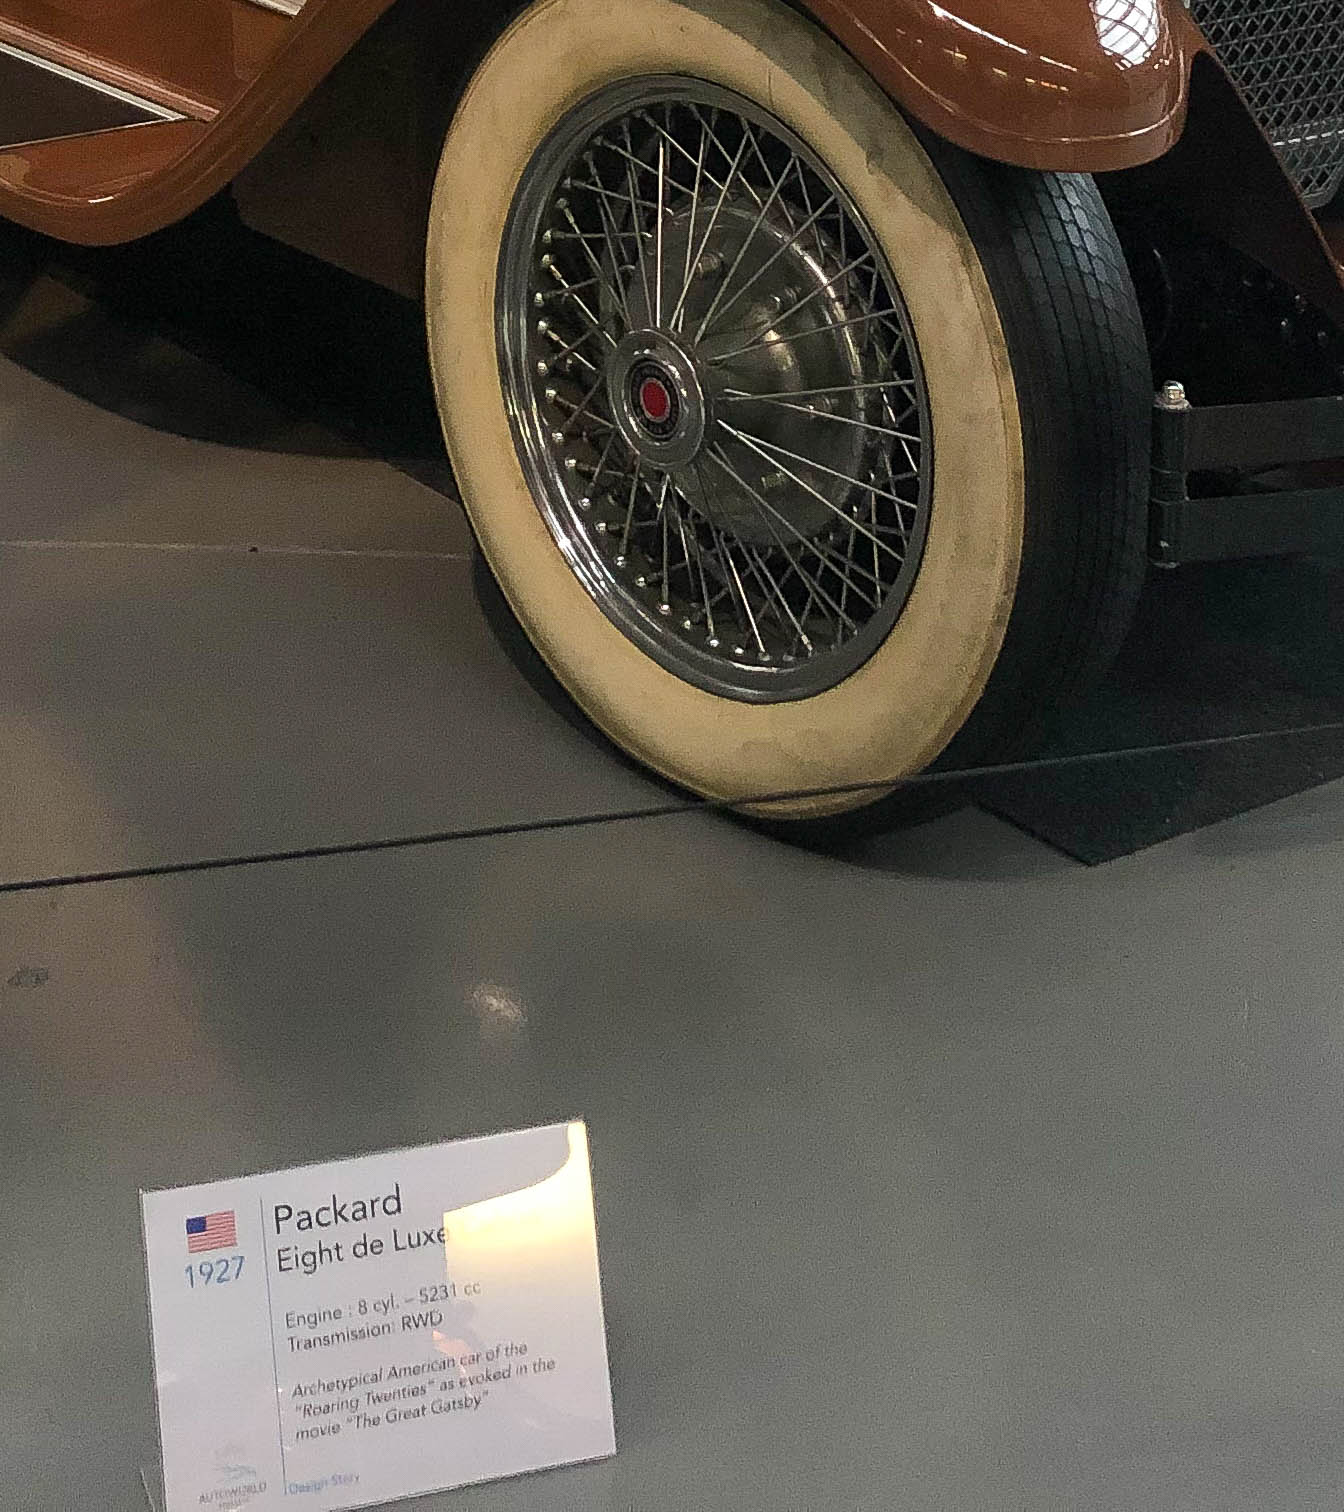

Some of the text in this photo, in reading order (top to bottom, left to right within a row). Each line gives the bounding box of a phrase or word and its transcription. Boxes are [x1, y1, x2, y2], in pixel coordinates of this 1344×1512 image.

[273, 1183, 403, 1235] Packard
[276, 1224, 449, 1275] Eight de Luxe
[184, 1255, 246, 1289] 1927
[285, 1307, 343, 1330] Engine
[358, 1299, 368, 1316] 8
[373, 1293, 400, 1316] cyl.
[419, 1283, 457, 1305] 5231
[463, 1280, 481, 1297] cc
[401, 1309, 444, 1332] RWD
[292, 1342, 528, 1398] Archetypical American car of the
[439, 1378, 455, 1392] as
[459, 1364, 512, 1388] evoked
[515, 1363, 528, 1377] in
[532, 1356, 556, 1374] the
[294, 1422, 341, 1441] movie
[385, 1403, 427, 1424] Great
